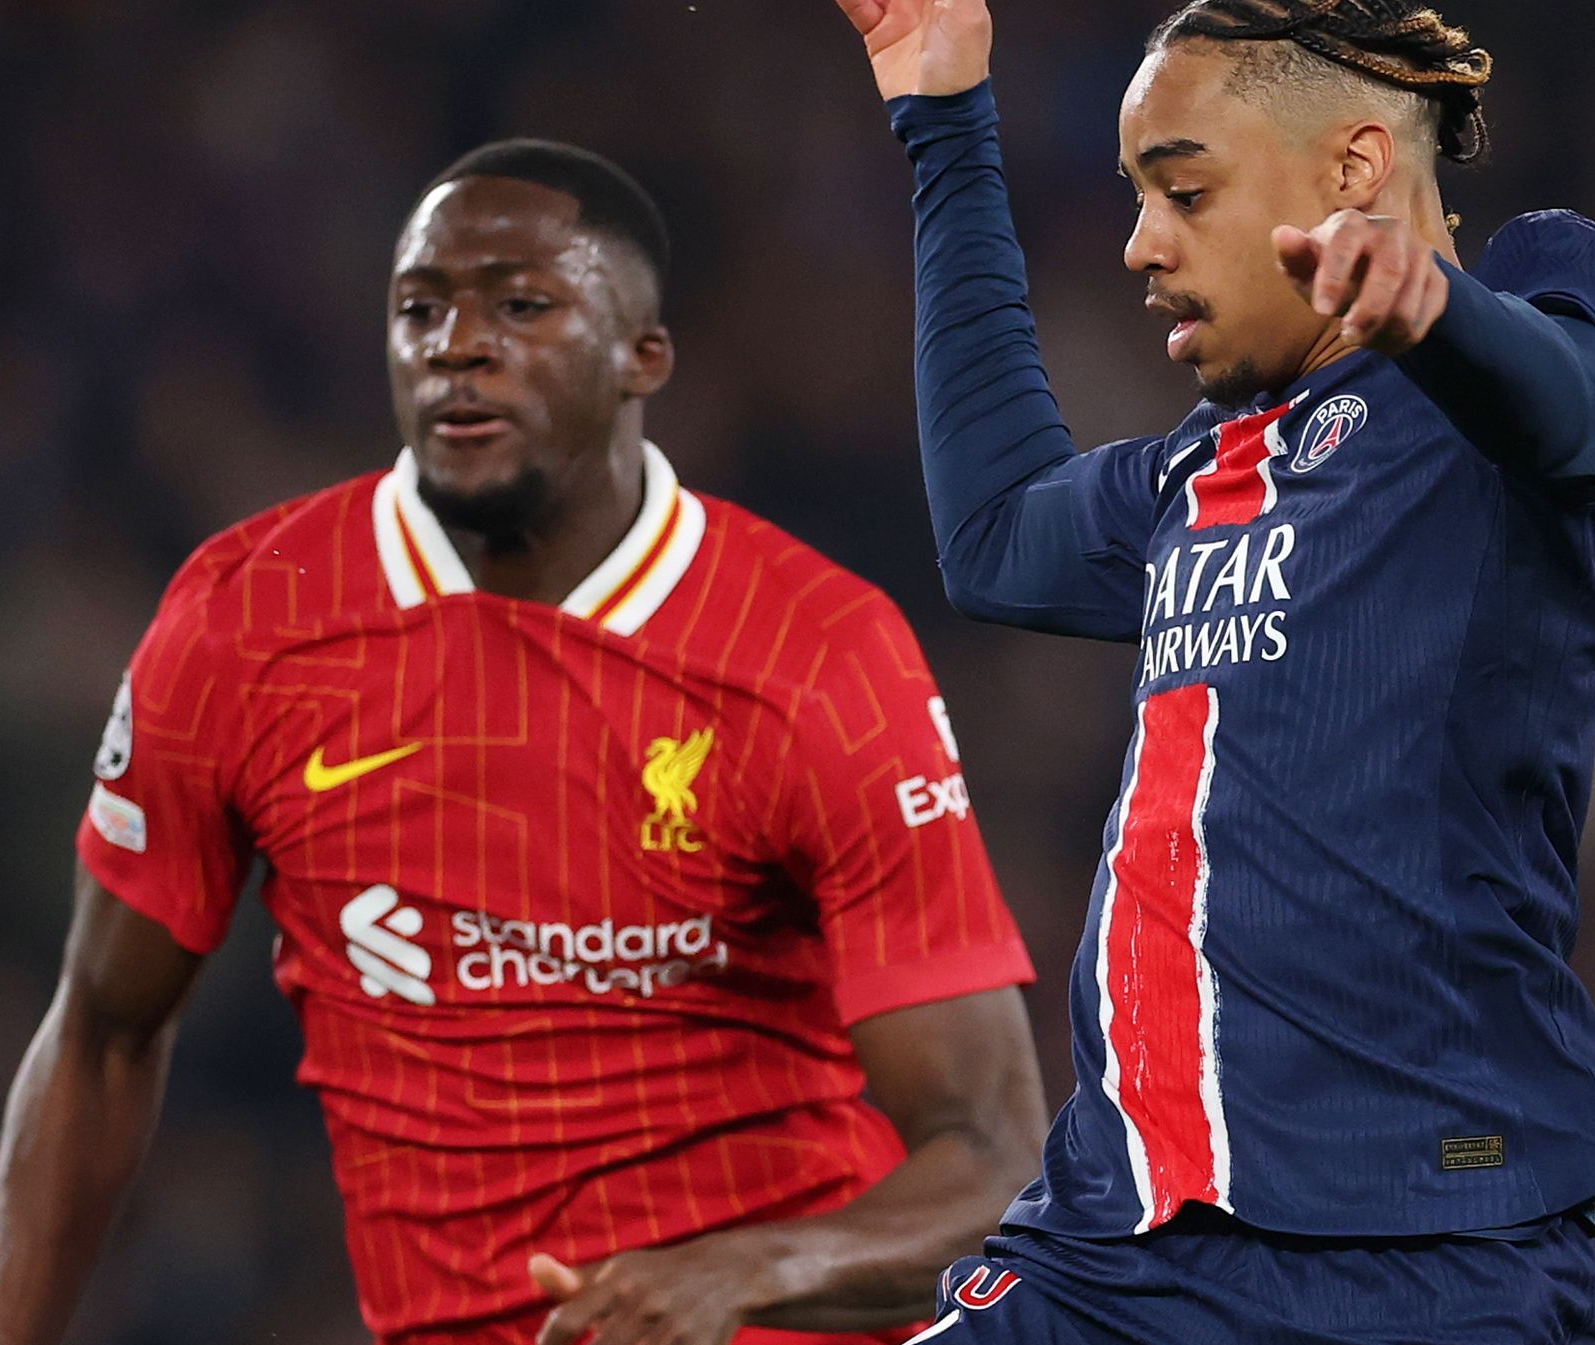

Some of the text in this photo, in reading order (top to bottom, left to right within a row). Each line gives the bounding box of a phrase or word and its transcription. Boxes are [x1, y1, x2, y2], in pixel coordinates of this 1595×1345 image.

[1317, 399, 1363, 424] PARIS
[1139, 610, 1288, 688] AIRWAYS
[452, 911, 713, 963] standard
